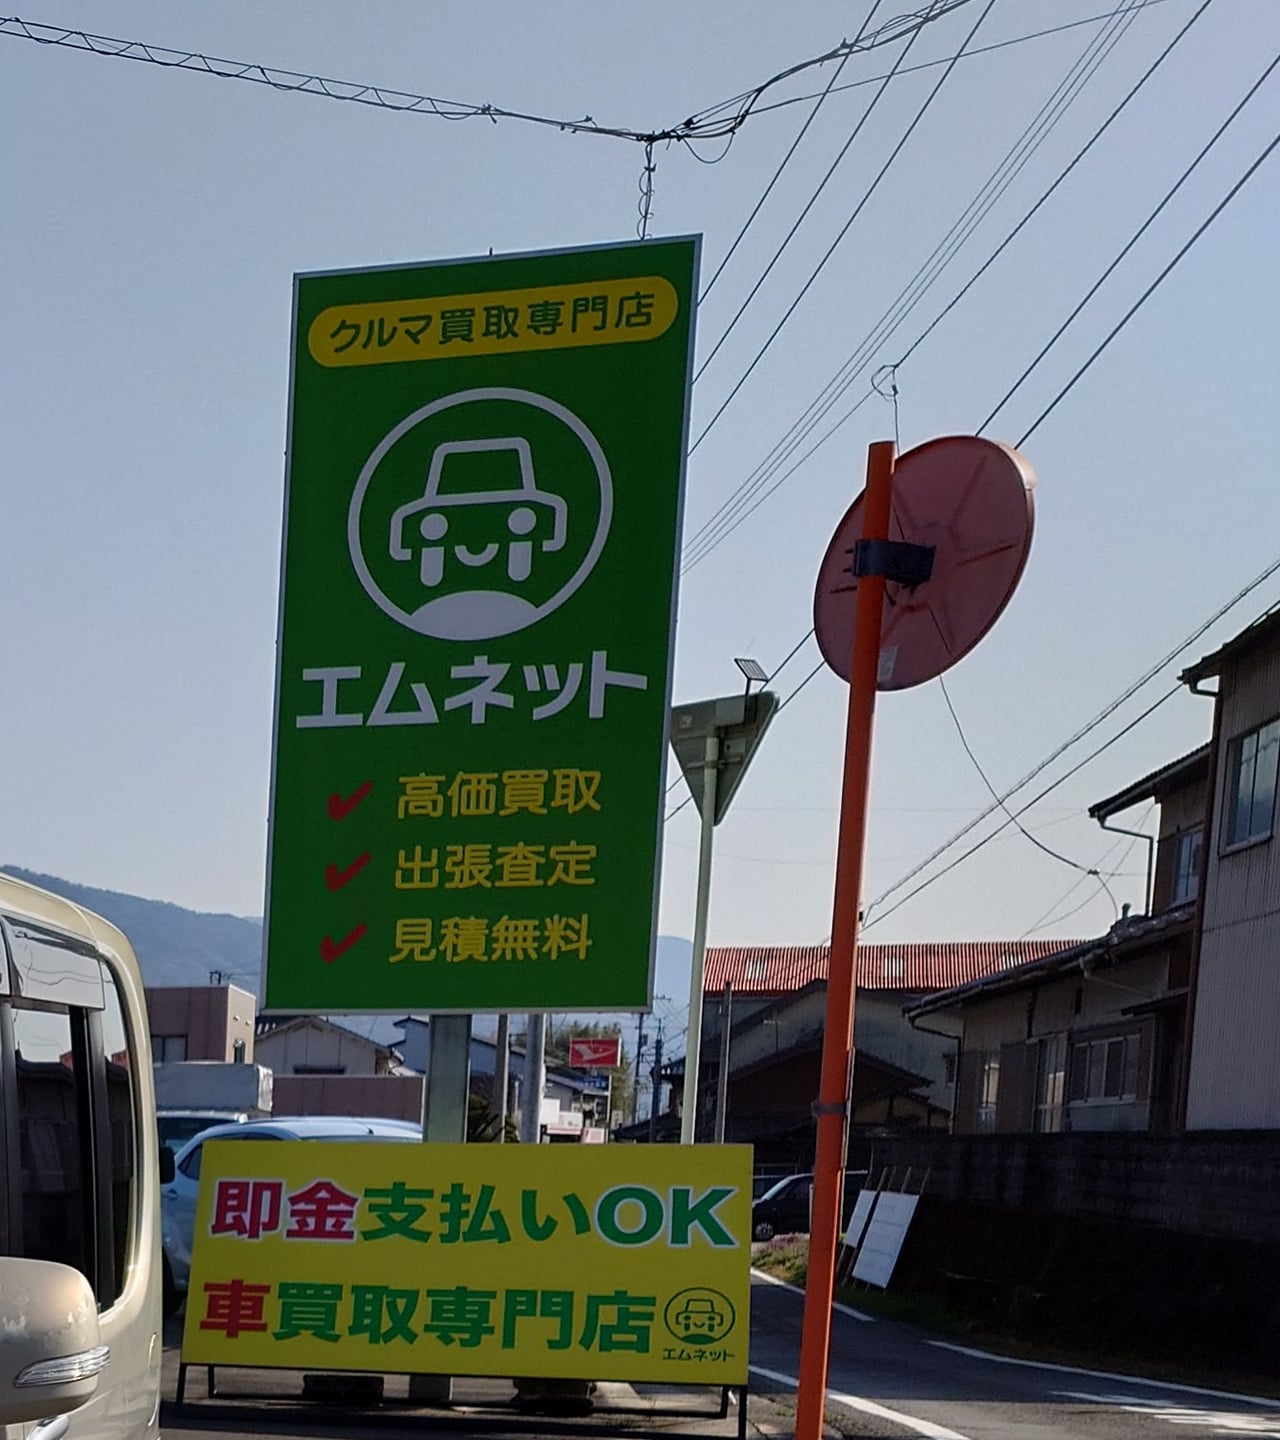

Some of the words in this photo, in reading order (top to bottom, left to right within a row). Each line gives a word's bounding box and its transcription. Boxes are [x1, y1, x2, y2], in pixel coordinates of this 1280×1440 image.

[329, 289, 656, 355] クルマ買取専門店
[296, 650, 648, 729] エムネット
[396, 767, 603, 820] 高価買取
[392, 841, 598, 891] 出張査定
[388, 914, 594, 963] 見積無料
[209, 1178, 740, 1249] 即金支払いOK
[199, 1280, 658, 1355] 車買取専門店
[662, 1348, 735, 1362] エムネット
